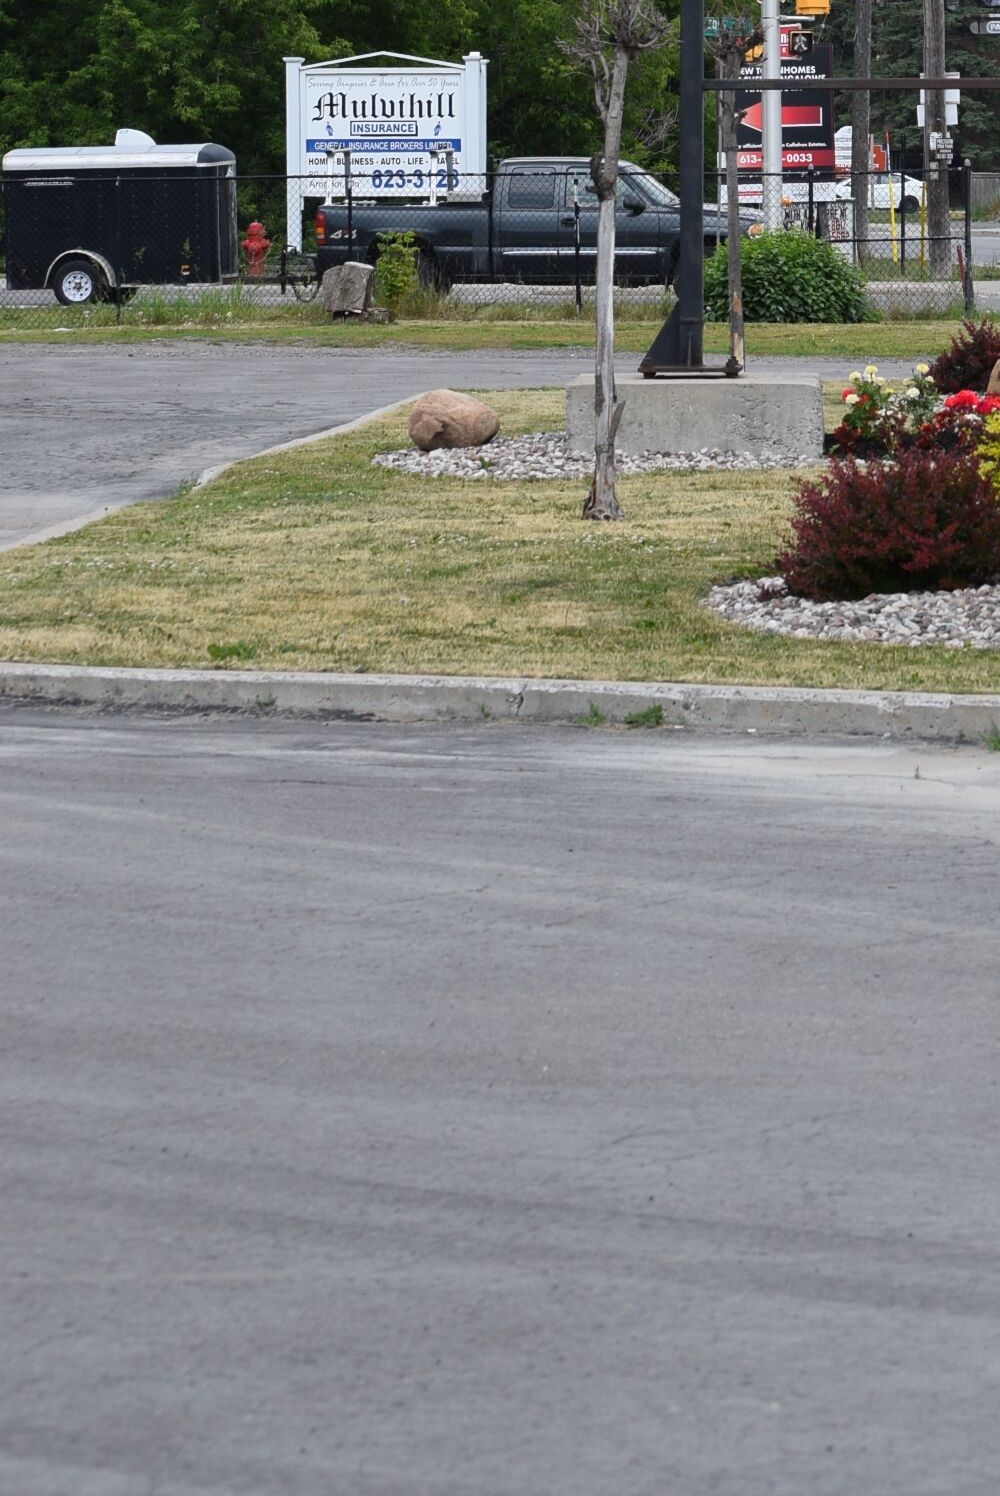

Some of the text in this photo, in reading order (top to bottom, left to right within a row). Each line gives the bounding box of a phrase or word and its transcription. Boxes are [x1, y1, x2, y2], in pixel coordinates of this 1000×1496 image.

[311, 91, 457, 122] Mulvihill
[352, 123, 415, 133] INSURANCE
[348, 141, 389, 151] INSURANCE
[390, 141, 423, 151] BROKERS
[336, 157, 374, 165] BUINESS
[380, 157, 401, 165] AUTO
[407, 157, 424, 165] LIFE
